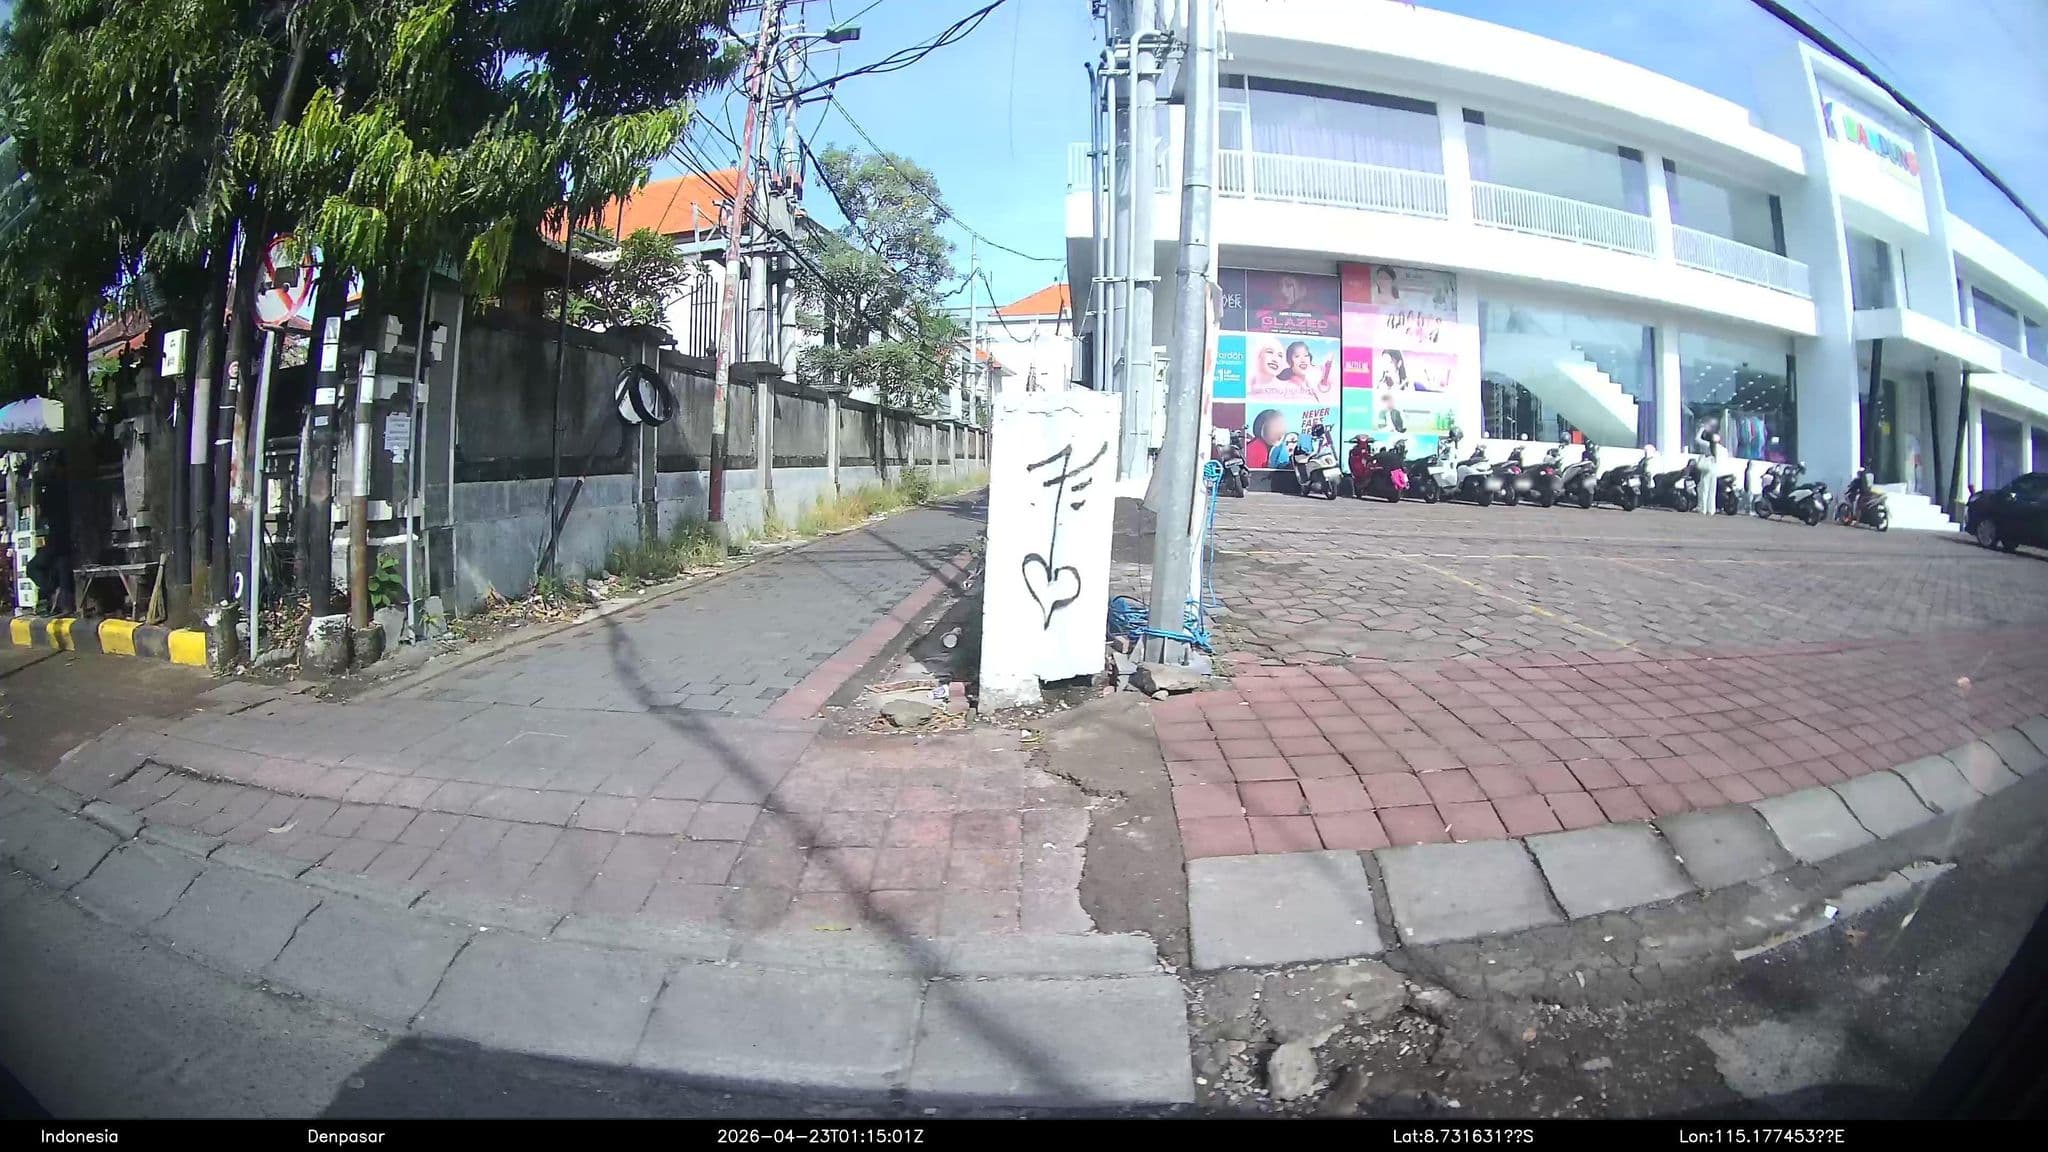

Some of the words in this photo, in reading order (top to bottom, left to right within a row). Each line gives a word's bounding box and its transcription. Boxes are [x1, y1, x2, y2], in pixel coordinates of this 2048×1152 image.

[1261, 316, 1328, 329] GLAZED
[1216, 351, 1244, 361] ardah
[1302, 407, 1331, 420] NEVER
